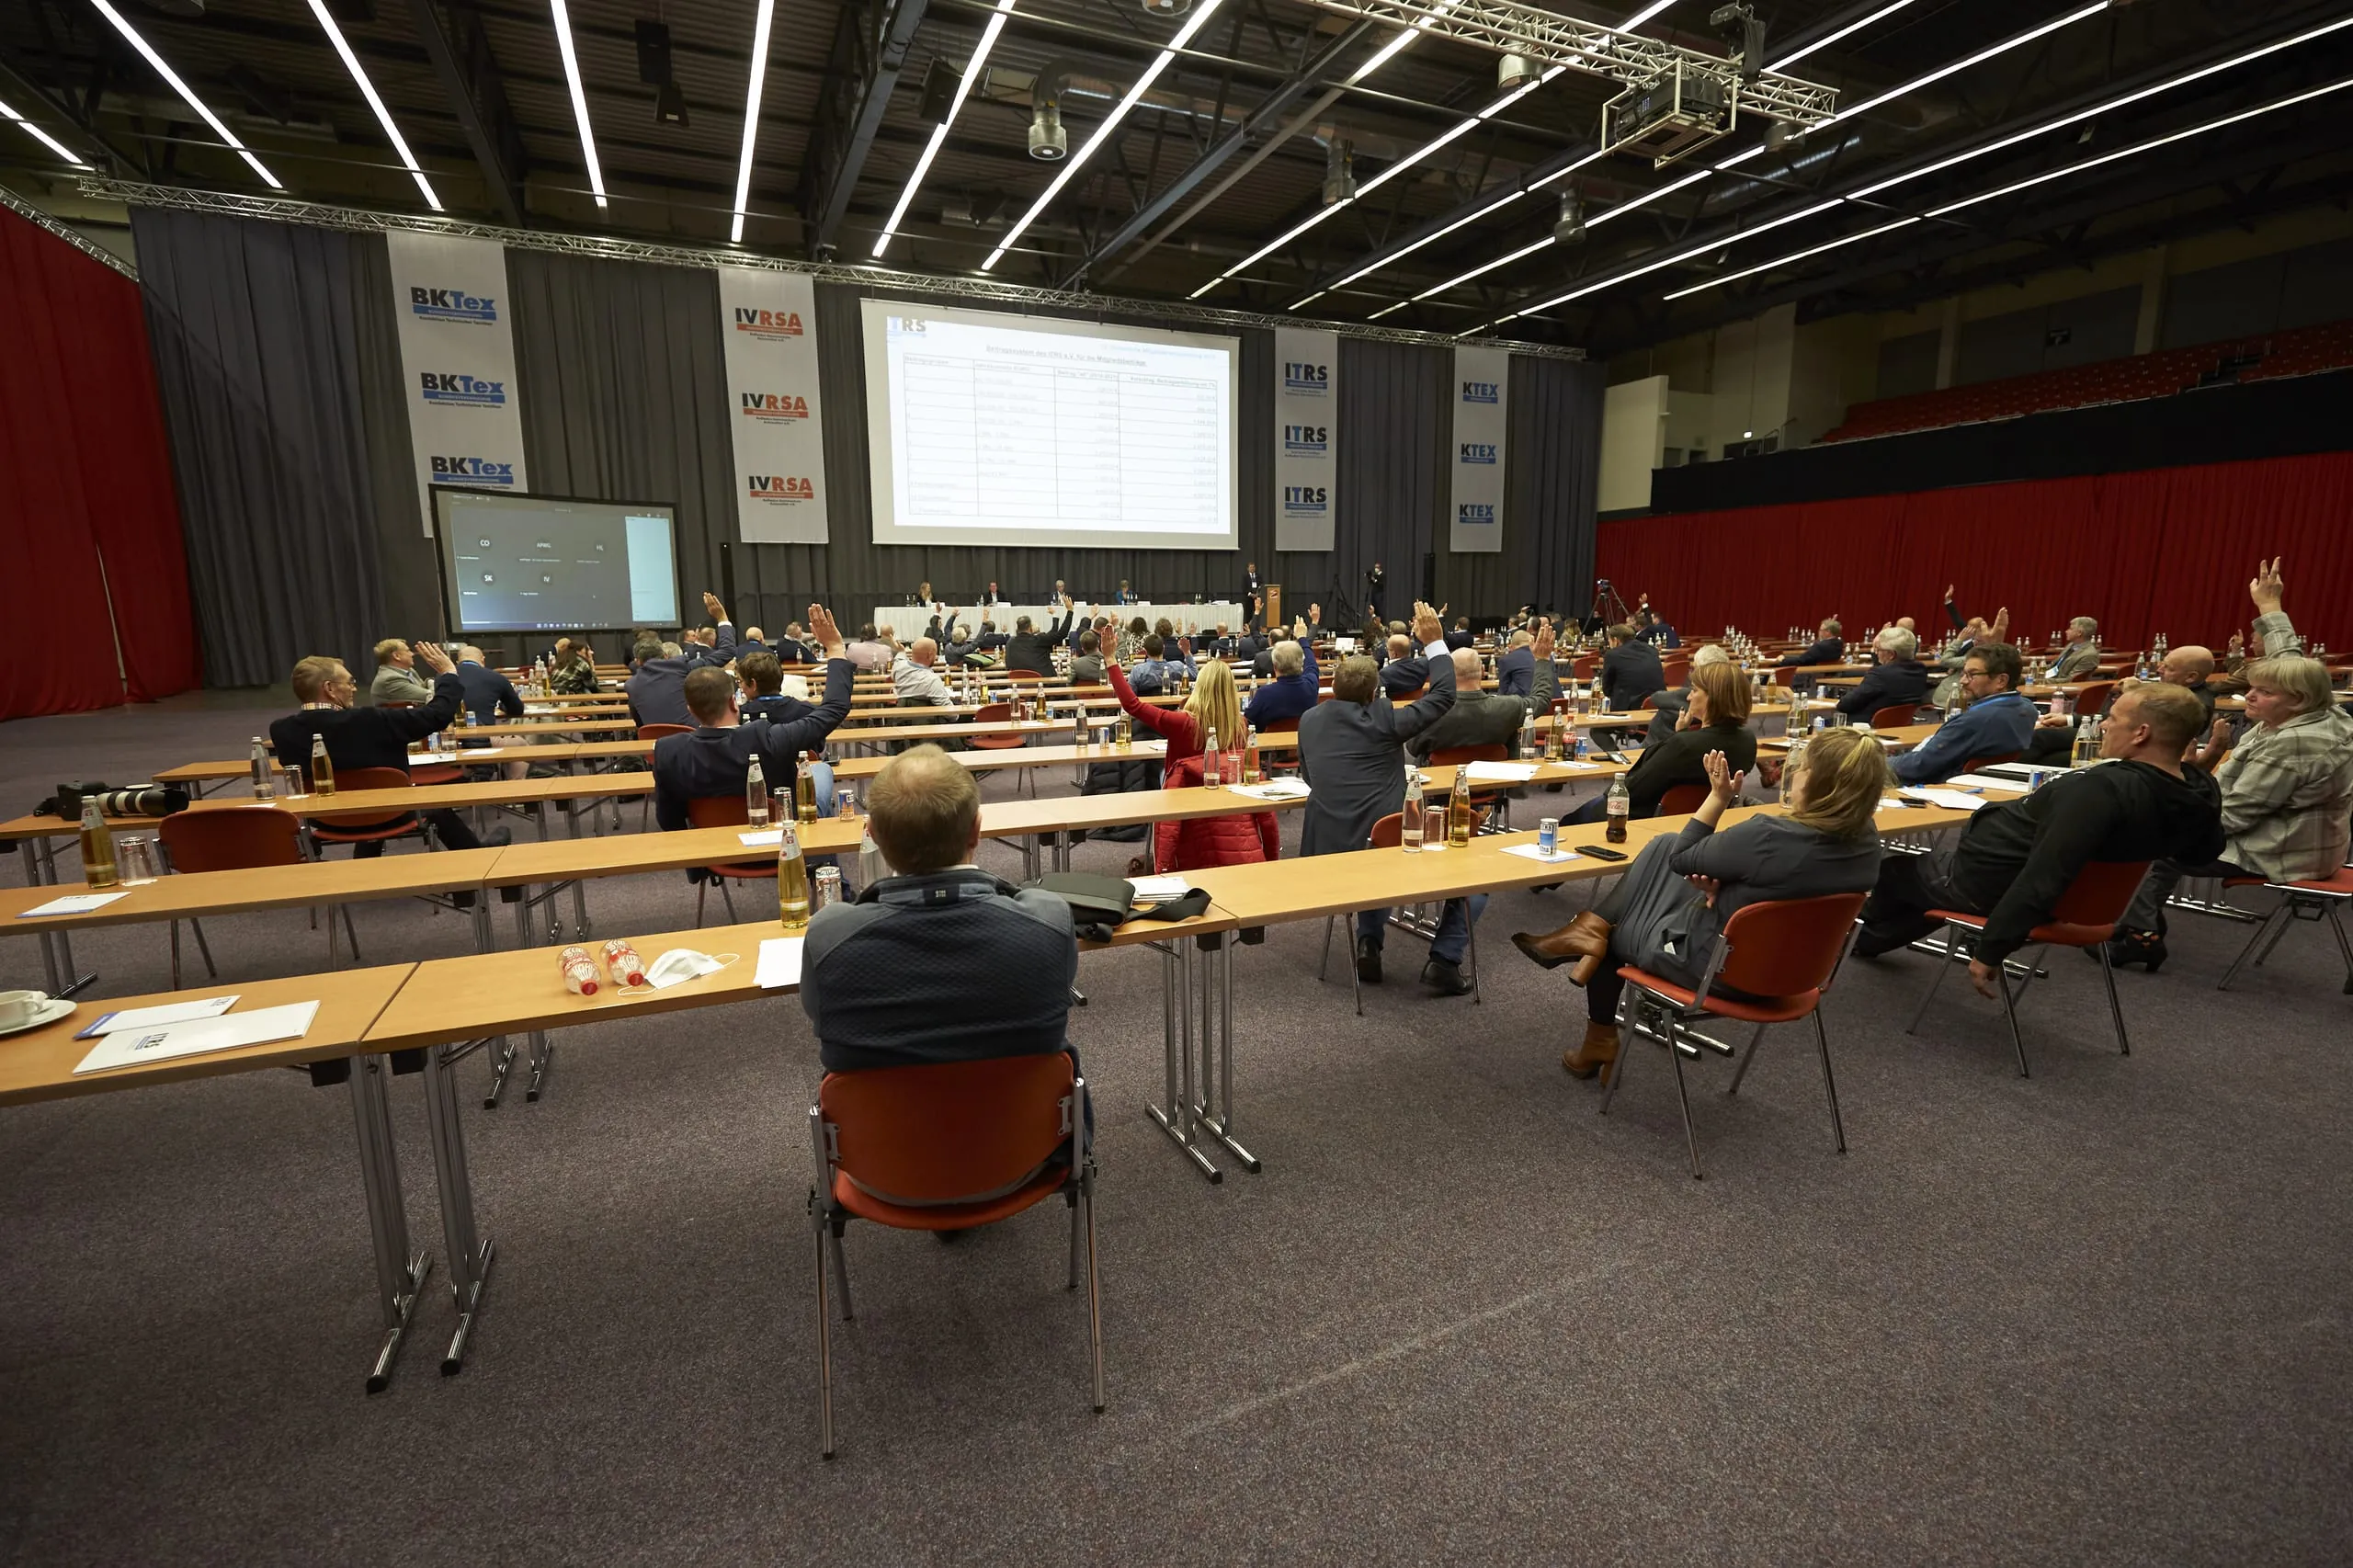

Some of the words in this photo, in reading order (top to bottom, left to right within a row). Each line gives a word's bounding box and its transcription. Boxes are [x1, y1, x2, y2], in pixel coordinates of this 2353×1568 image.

[411, 287, 495, 311] BKTex
[735, 308, 801, 327] IVRSA
[1285, 362, 1327, 381] ITRS
[420, 372, 504, 394] BKTex
[1462, 381, 1498, 397] KTEX
[742, 392, 808, 411] IVRSA
[1285, 425, 1326, 442] ITRS
[1461, 443, 1496, 458] KTEX
[430, 456, 513, 475] BKTex
[748, 475, 813, 492] IVRSA
[1285, 486, 1326, 503] ITRS
[1460, 504, 1495, 517] KTEX
